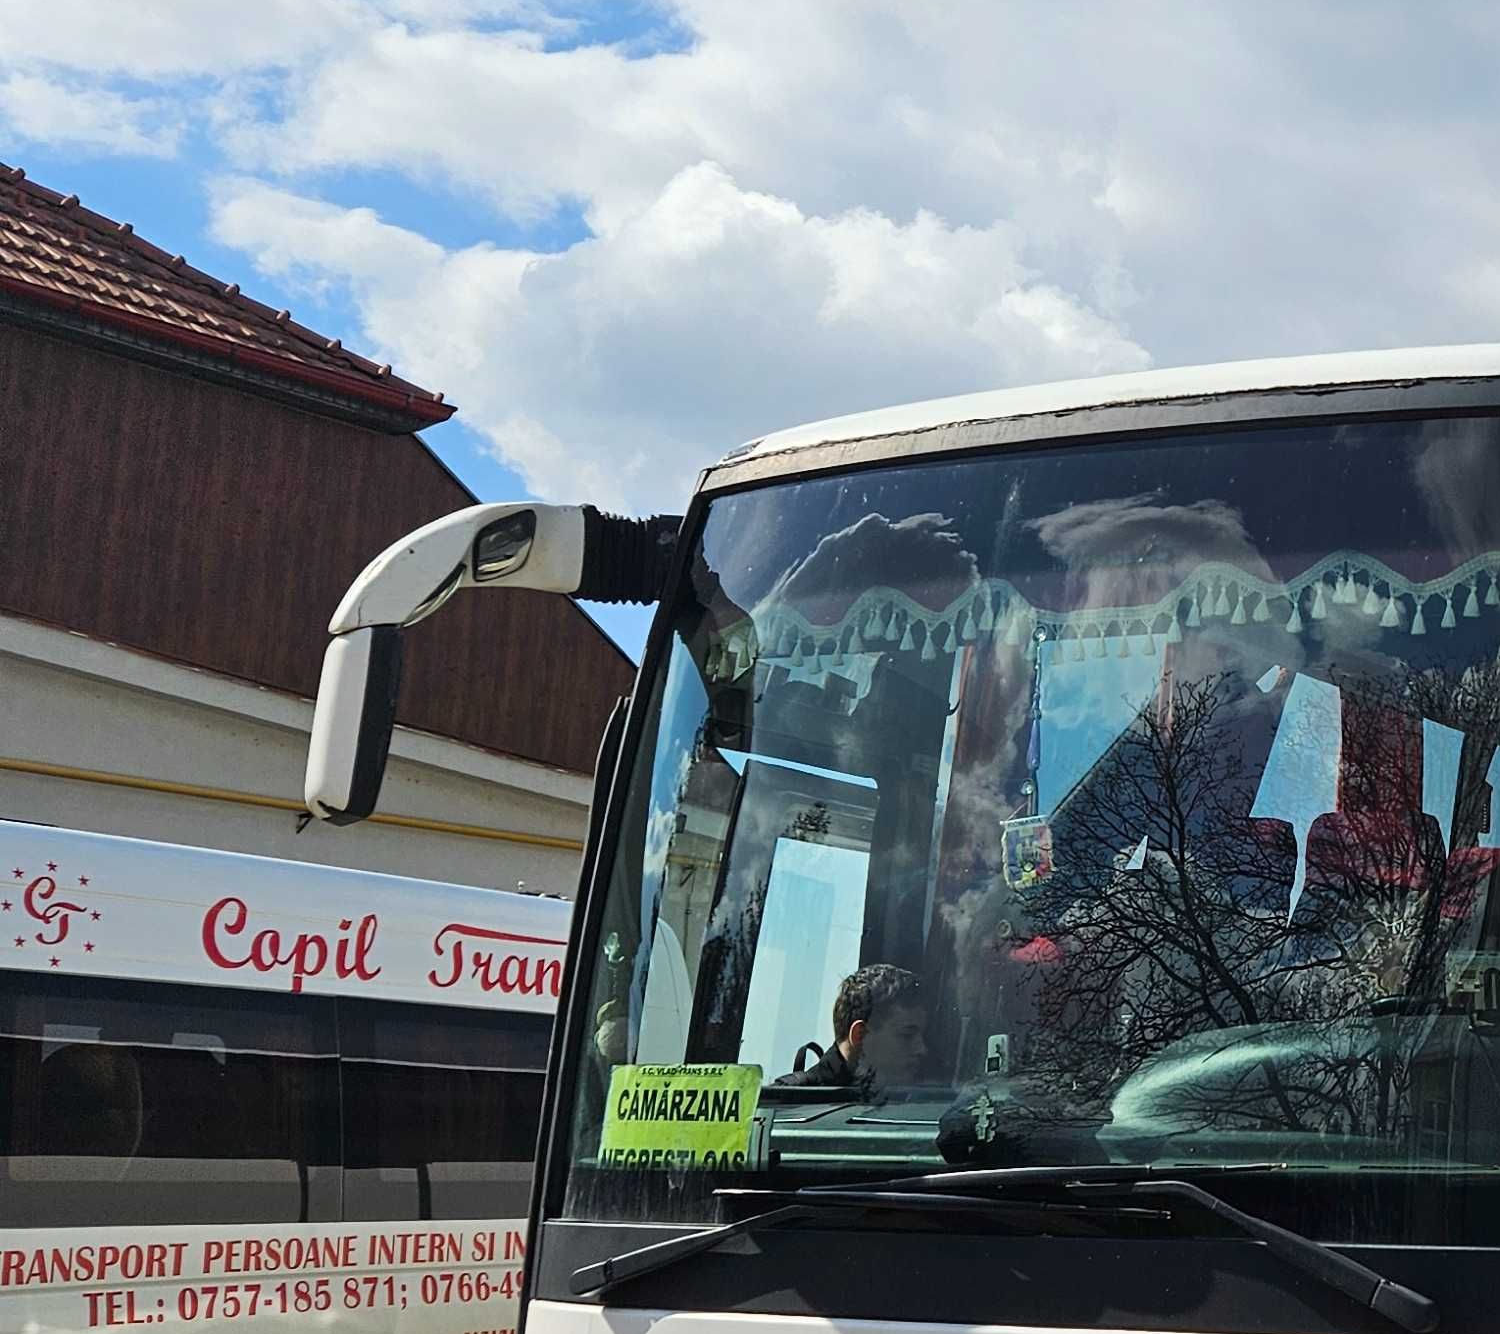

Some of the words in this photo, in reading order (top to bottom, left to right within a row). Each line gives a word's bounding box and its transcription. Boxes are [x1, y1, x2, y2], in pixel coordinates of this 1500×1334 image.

[202, 897, 382, 993] Copil
[428, 923, 568, 997] Tran
[617, 1081, 740, 1122] CĂMĂRZANA
[0, 1243, 189, 1286] RANSPORT
[202, 1235, 358, 1274] PERSOANE
[368, 1232, 463, 1265] INTERN
[471, 1231, 496, 1262] SI
[82, 1291, 164, 1327] TEL.:
[177, 1278, 332, 1321] 0757-185
[343, 1275, 408, 1310] 871;
